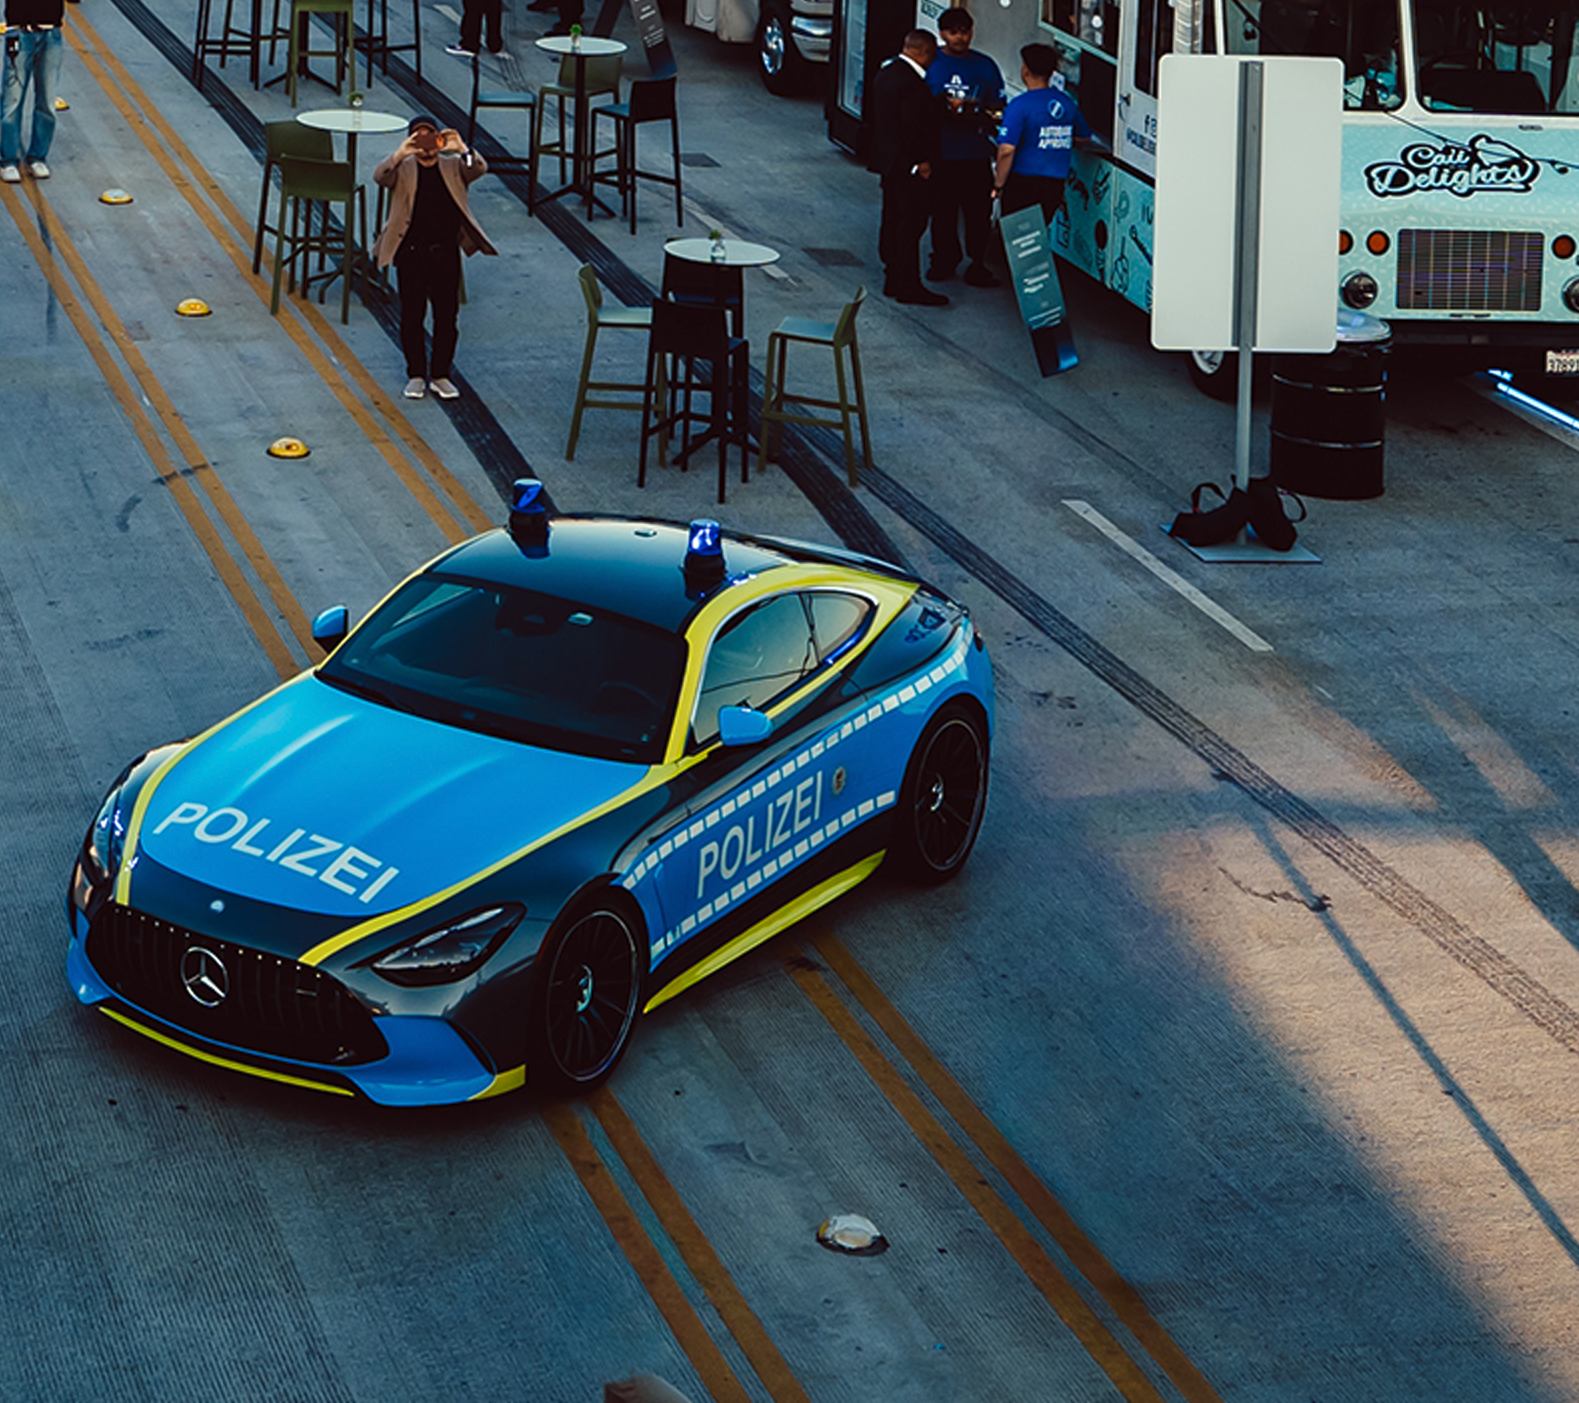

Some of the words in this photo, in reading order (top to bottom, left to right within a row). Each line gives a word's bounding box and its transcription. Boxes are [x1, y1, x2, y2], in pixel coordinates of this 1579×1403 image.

[1370, 159, 1535, 194] Delights
[152, 801, 400, 904] POLIZEI
[697, 770, 823, 899] POLIZEI
